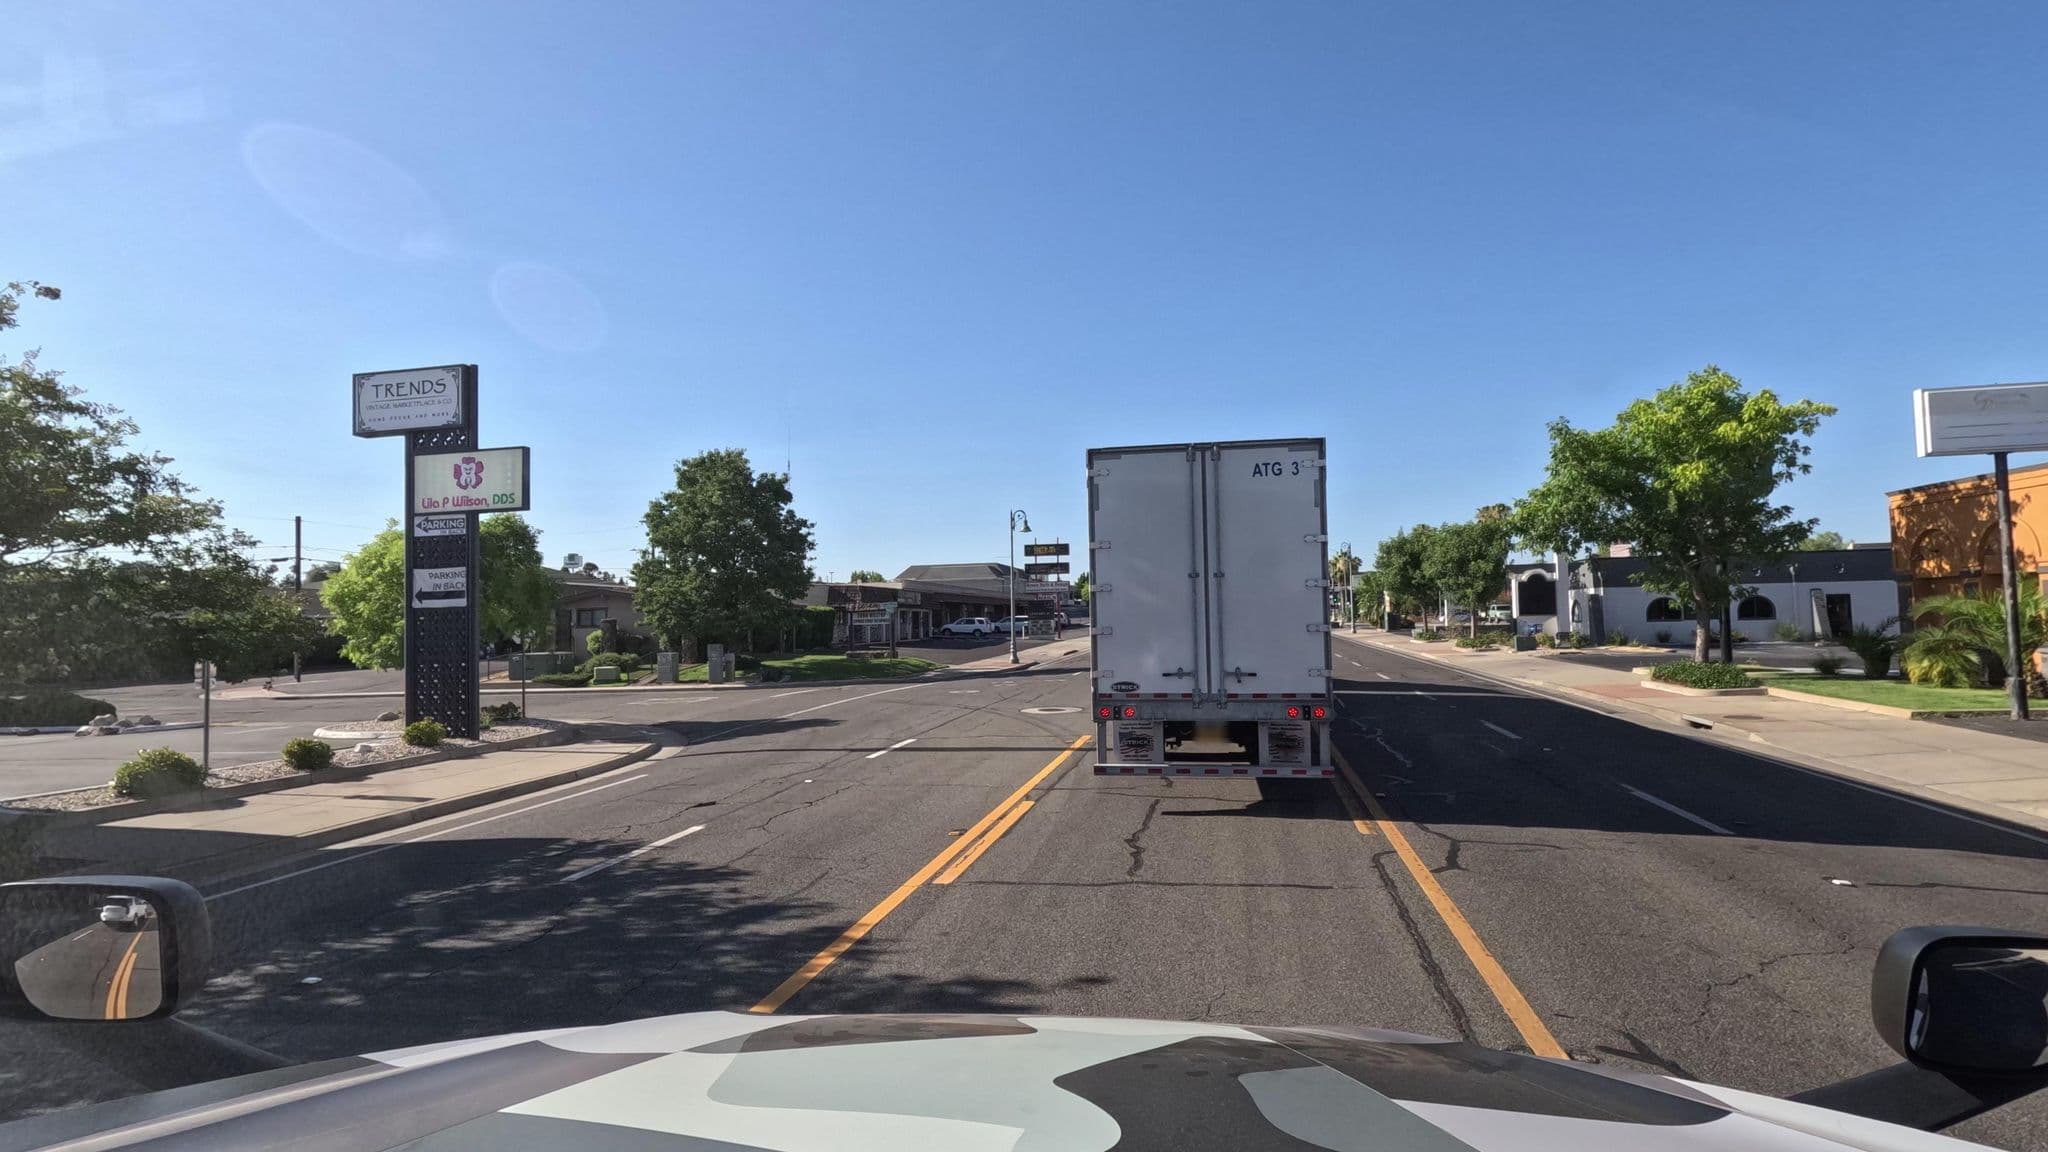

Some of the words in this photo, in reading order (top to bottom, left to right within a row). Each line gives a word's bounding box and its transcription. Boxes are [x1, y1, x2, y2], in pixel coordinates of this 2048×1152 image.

[371, 378, 447, 399] TRENDS
[366, 403, 391, 411] VINTAGE
[393, 399, 435, 408] MARKETPLACE
[1252, 461, 1282, 477] ATG
[1291, 461, 1300, 476] 3
[422, 497, 440, 509] Lila
[442, 496, 449, 508] P
[452, 495, 489, 508] Wilson,
[492, 493, 515, 505] DDS
[421, 519, 465, 529] PARKING
[432, 583, 441, 591] IN
